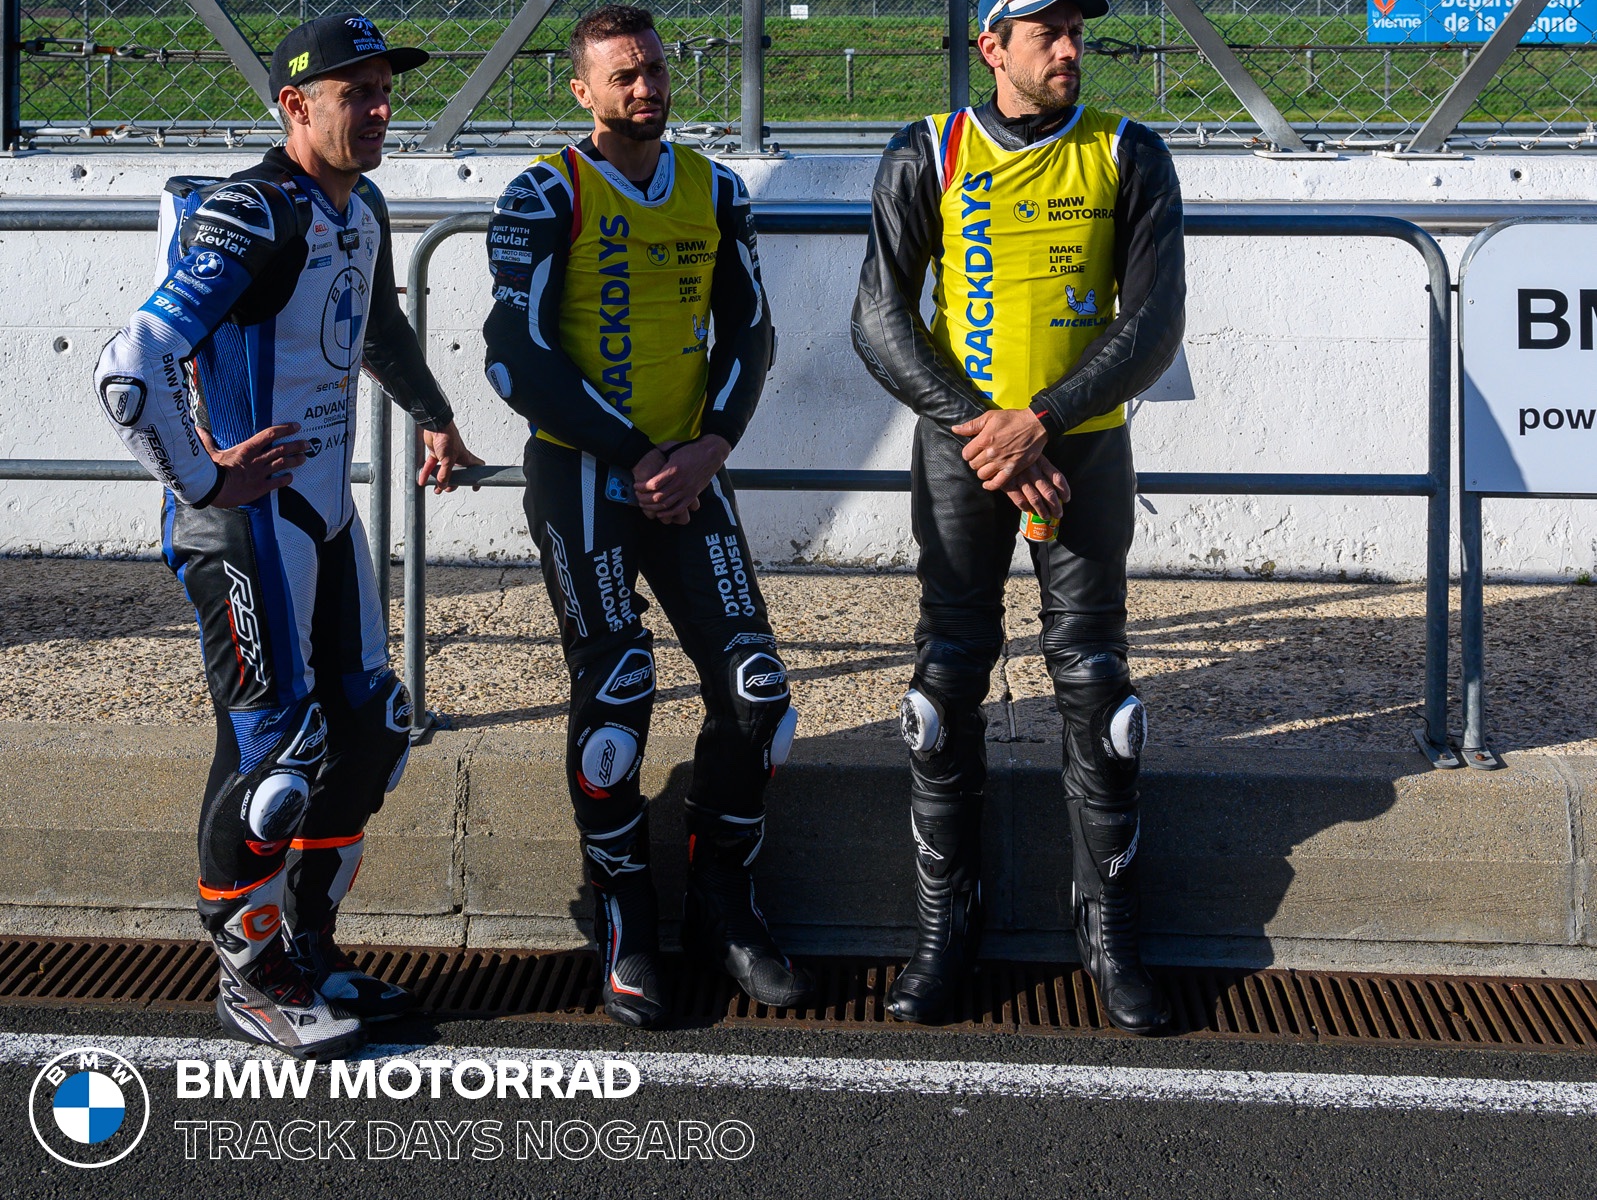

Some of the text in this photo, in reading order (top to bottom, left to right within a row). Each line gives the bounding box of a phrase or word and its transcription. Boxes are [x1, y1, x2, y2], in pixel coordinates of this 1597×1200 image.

[1373, 17, 1422, 29] vienne
[1444, 12, 1470, 32] de
[1477, 12, 1496, 32] la
[288, 51, 310, 77] 78
[1047, 196, 1085, 208] BMW
[1048, 208, 1115, 222] MOTORRA
[199, 224, 252, 246] BUILT WITH
[314, 224, 328, 233] BELL
[509, 226, 531, 235] WITH
[502, 249, 519, 257] MOTO
[676, 240, 707, 252] BMW
[1049, 245, 1083, 254] MAKE
[1049, 255, 1073, 264] LIFE
[1049, 265, 1085, 273] A RIDE
[679, 275, 702, 286] MAKE
[679, 286, 698, 295] LIFE
[162, 352, 179, 388] BMW
[172, 388, 200, 458] MOTORRAD
[140, 424, 187, 493] TECMAS
[706, 533, 729, 576] RIDE
[725, 534, 756, 617] OULOUSE
[610, 666, 652, 692] RST
[745, 671, 787, 688] RST
[577, 726, 592, 747] FACTORY
[599, 739, 616, 785] RST
[240, 788, 252, 821] FACTORY
